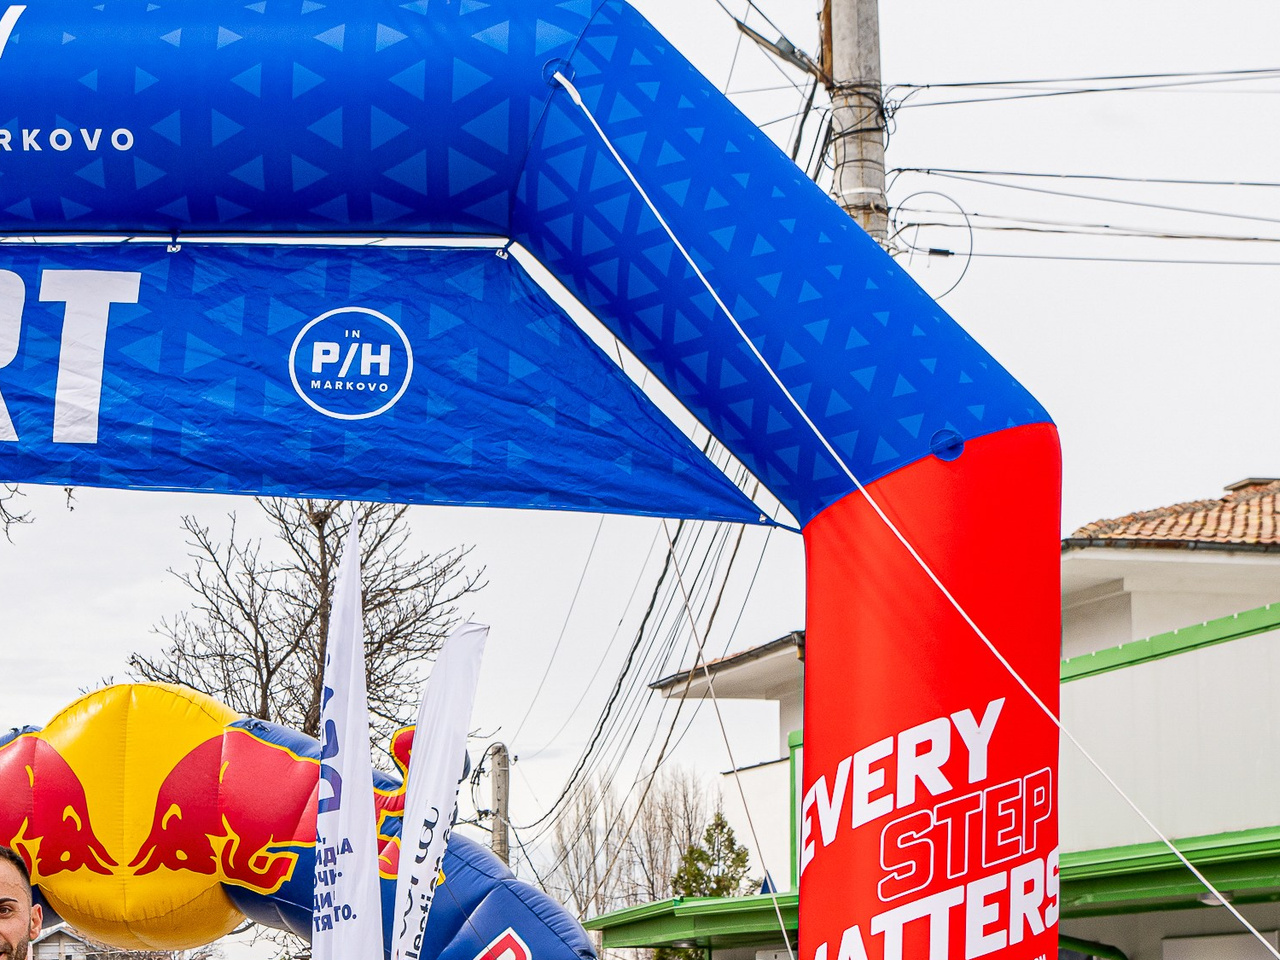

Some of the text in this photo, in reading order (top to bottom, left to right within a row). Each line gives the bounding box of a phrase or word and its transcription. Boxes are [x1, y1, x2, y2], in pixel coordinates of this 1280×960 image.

[345, 329, 361, 339] IN
[311, 341, 391, 378] P/H
[310, 380, 389, 393] MARKOVO
[799, 697, 1006, 877] EVERY
[877, 766, 1053, 903] STEP
